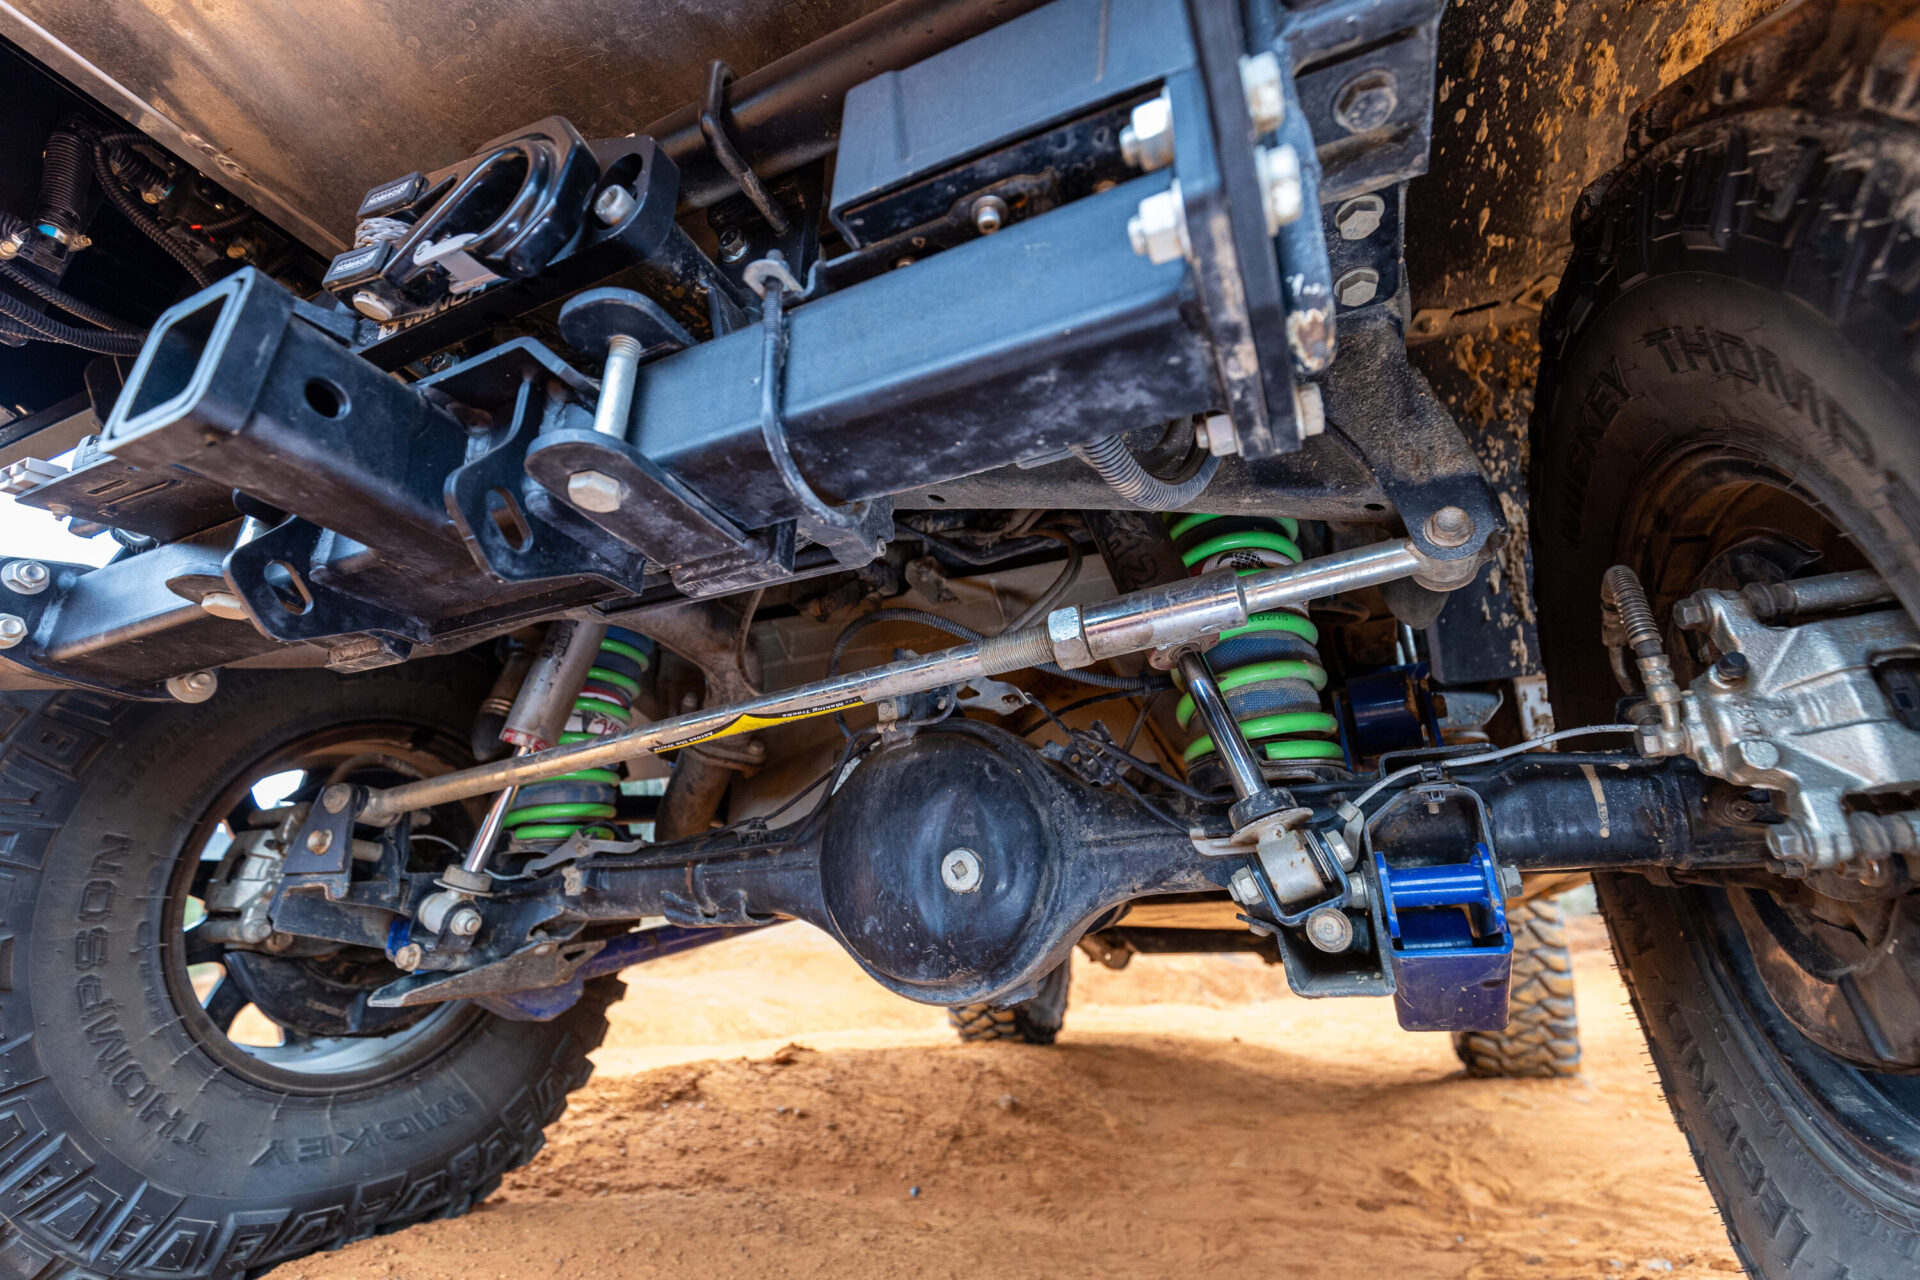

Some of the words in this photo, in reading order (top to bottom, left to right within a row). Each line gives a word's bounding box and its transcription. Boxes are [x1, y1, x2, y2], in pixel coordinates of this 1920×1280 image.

[1560, 354, 1635, 550] MICKEY
[73, 831, 208, 1156] THOMPSON
[249, 1096, 470, 1168] MICKEY
